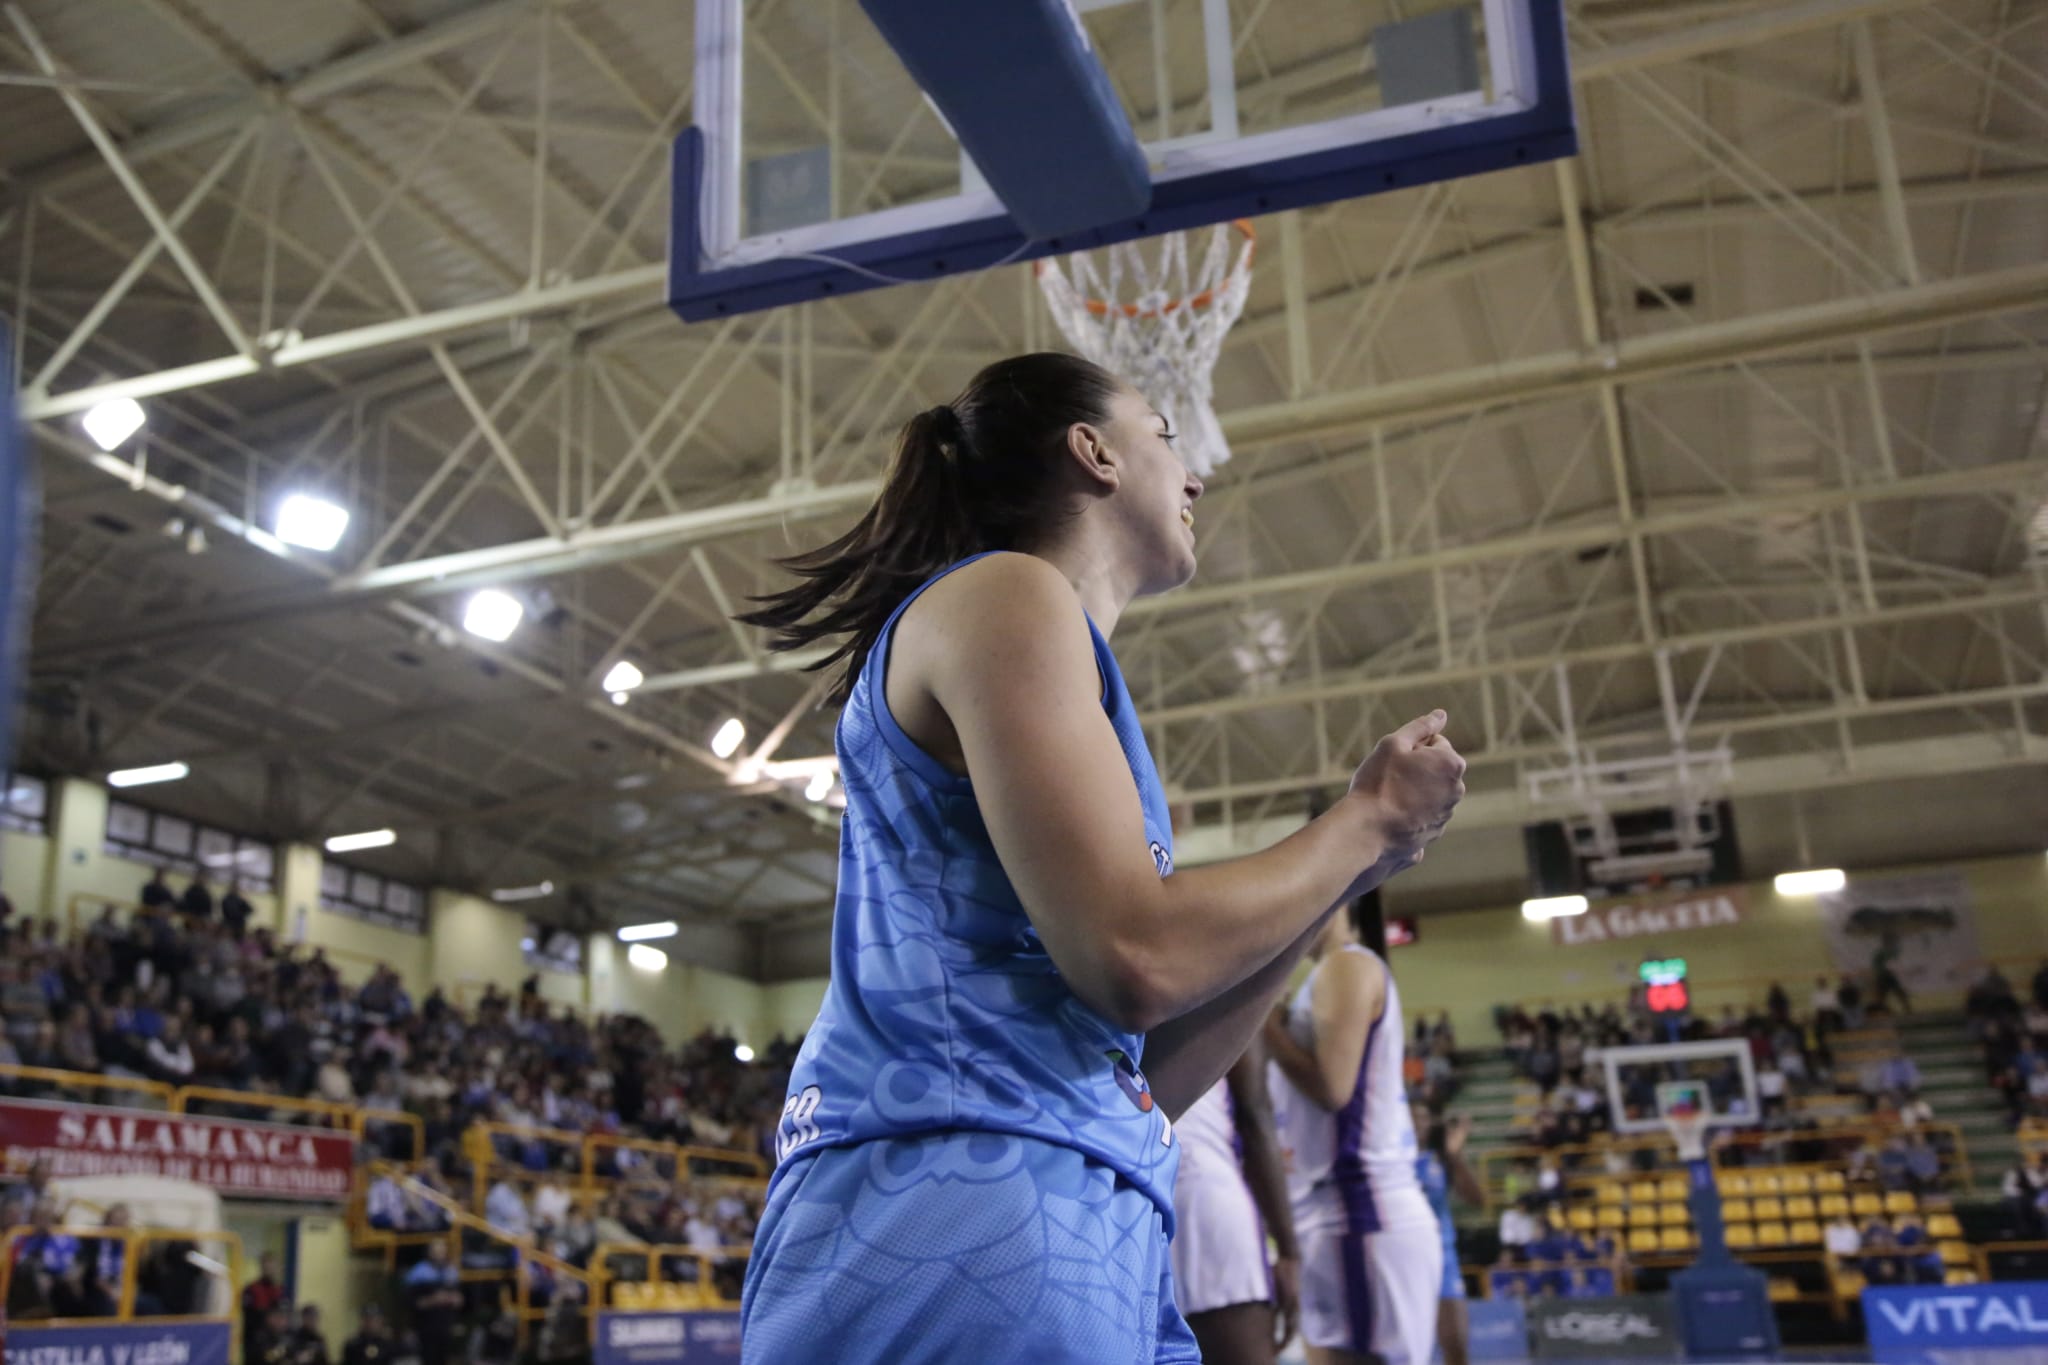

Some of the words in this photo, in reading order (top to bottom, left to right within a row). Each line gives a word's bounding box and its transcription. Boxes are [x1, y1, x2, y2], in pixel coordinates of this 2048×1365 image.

[1560, 914, 1607, 944] LA
[1606, 896, 1739, 938] GACETA
[56, 1110, 318, 1165] SALAMANCA
[1878, 1295, 2048, 1334] VITAL
[4, 1345, 105, 1365] CASTILLA
[111, 1342, 132, 1365] Y
